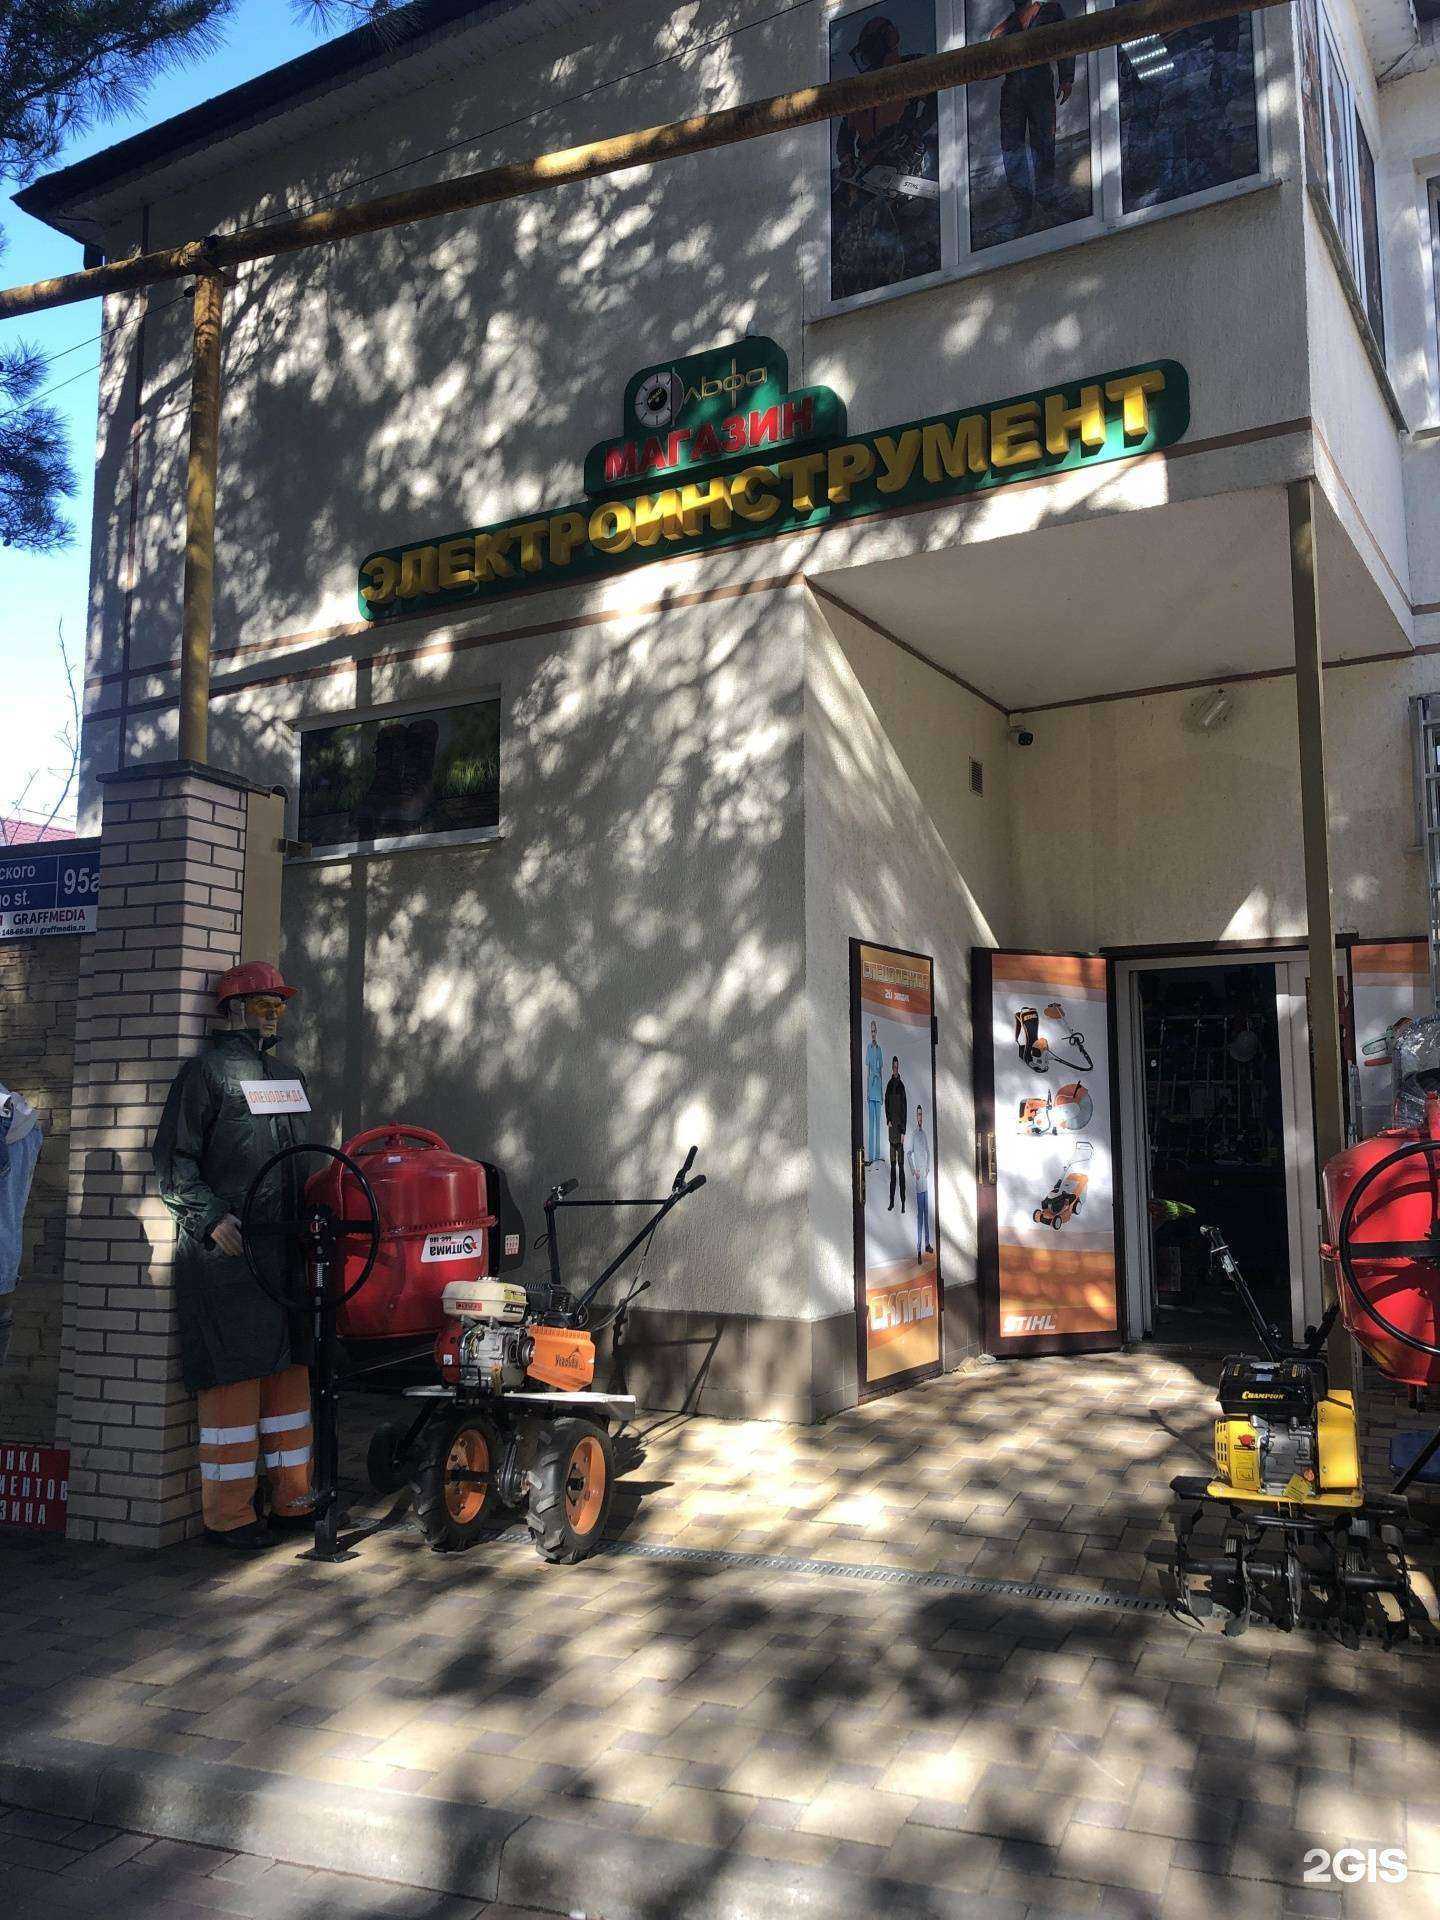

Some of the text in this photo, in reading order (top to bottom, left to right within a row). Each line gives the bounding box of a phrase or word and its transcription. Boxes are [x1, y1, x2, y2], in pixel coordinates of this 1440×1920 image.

[604, 394, 816, 482] МАГАЗИН
[360, 369, 1166, 604] ЭЛЕКТРОИНСТРУМЕНТ
[14, 889, 31, 906] st.
[13, 909, 86, 925] GRAFFMEDIA
[870, 1285, 934, 1331] СКЛАД
[1002, 1314, 1057, 1332] STIHL
[0, 1449, 40, 1473] НКА
